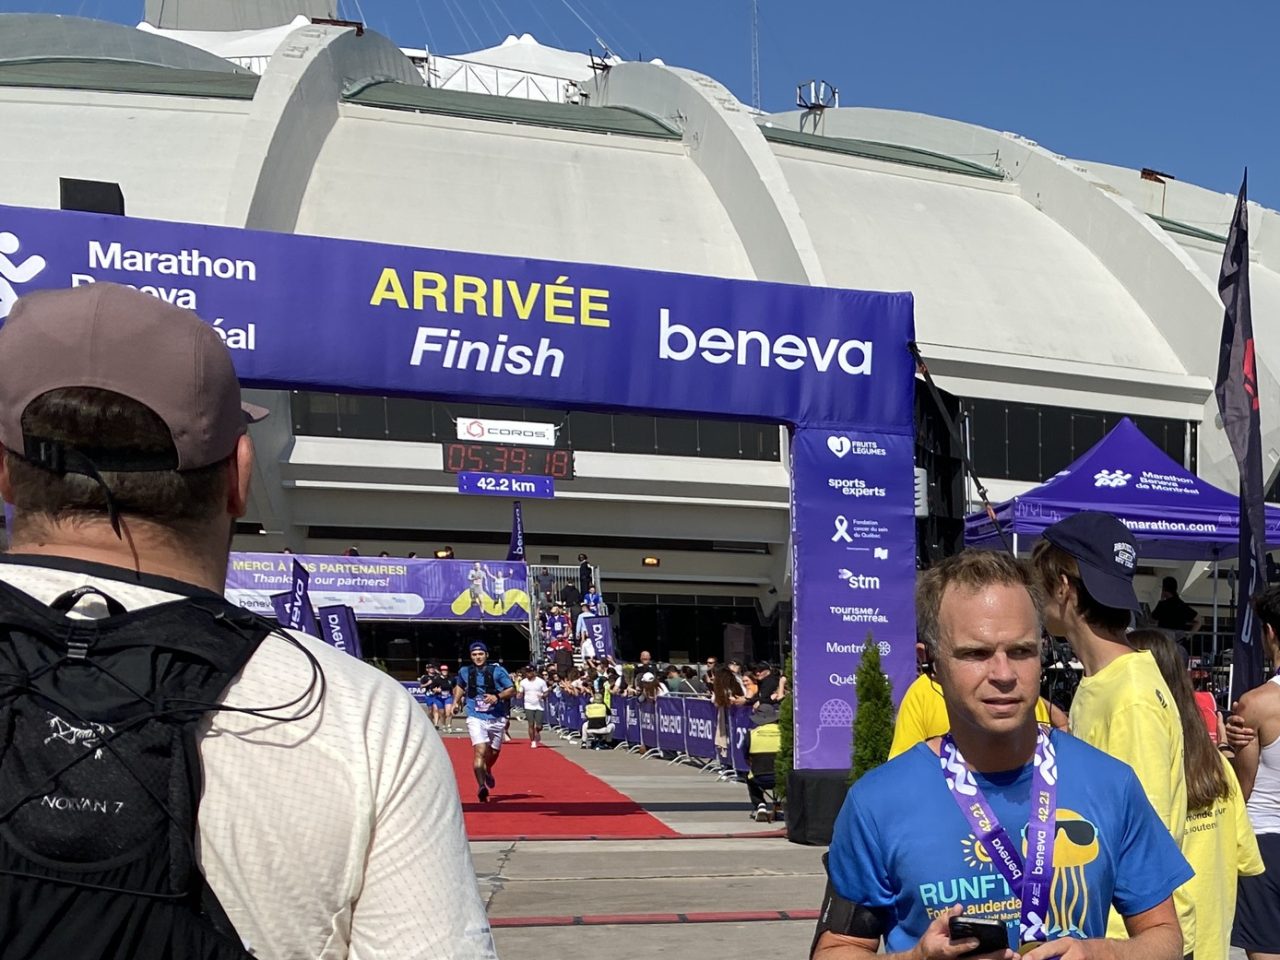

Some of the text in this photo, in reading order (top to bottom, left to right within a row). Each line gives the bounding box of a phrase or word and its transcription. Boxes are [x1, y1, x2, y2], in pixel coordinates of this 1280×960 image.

[88, 240, 256, 281] Marathon
[369, 267, 611, 328] ARRIVÉE
[658, 308, 873, 376] beneva
[409, 326, 565, 378] Finish
[487, 427, 546, 438] COROS
[852, 441, 877, 449] FRUITS
[852, 448, 887, 456] LEGUMES
[447, 443, 568, 477] 05:39:18
[476, 477, 536, 493] 42.2 km
[828, 478, 866, 489] sports
[1135, 482, 1150, 490] de
[1142, 471, 1194, 485] Marathon
[842, 487, 886, 497] experts
[1118, 518, 1217, 533] lmarathon.com
[232, 560, 275, 571] MERCI
[278, 561, 287, 572] À
[320, 563, 408, 576] PARTENAIRES!
[314, 577, 336, 586] our
[336, 576, 390, 588] partners!
[849, 574, 880, 590] stm
[239, 599, 275, 608] benev
[688, 710, 712, 740] beneva
[113, 801, 124, 813] 7
[991, 838, 1022, 880] beneva
[1031, 830, 1046, 875] beneva
[919, 873, 1010, 906] RUNFT
